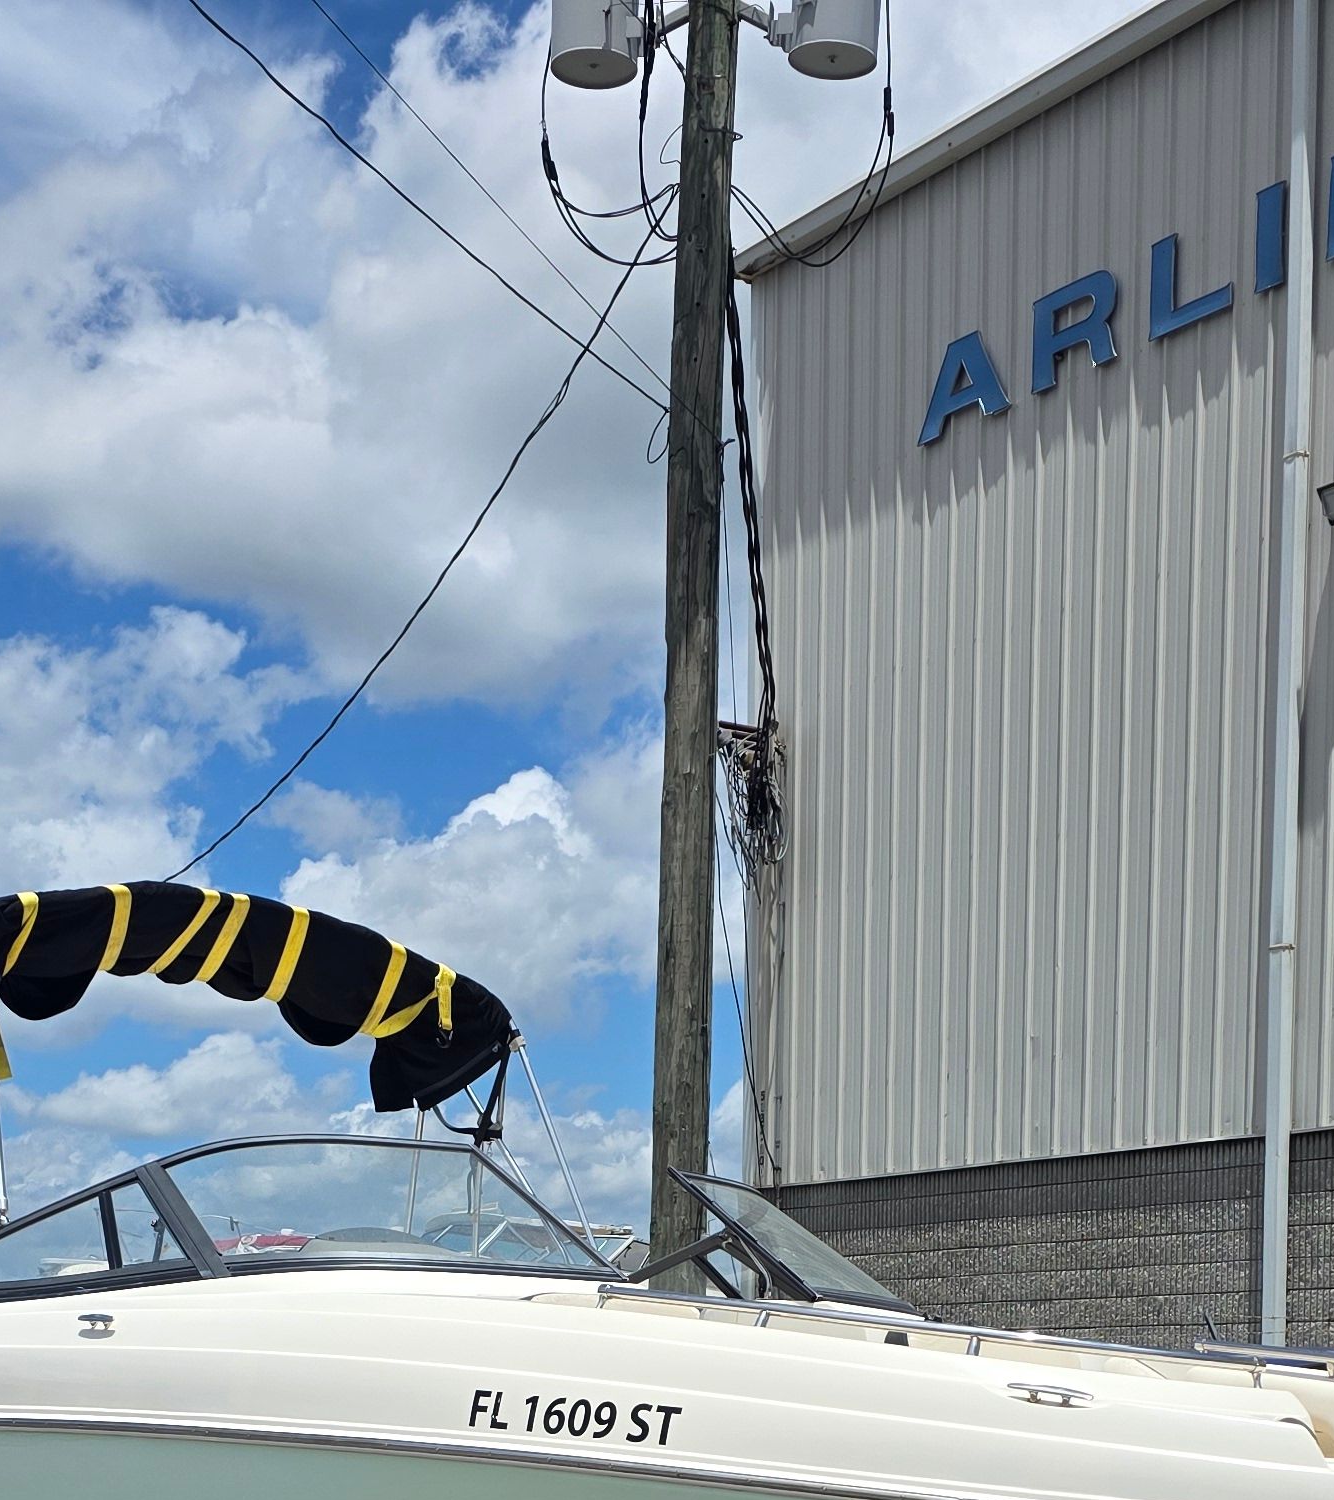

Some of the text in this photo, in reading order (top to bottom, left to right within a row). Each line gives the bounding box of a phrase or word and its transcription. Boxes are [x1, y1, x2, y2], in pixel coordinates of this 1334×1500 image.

[468, 1389, 683, 1446] FL 1609 ST
